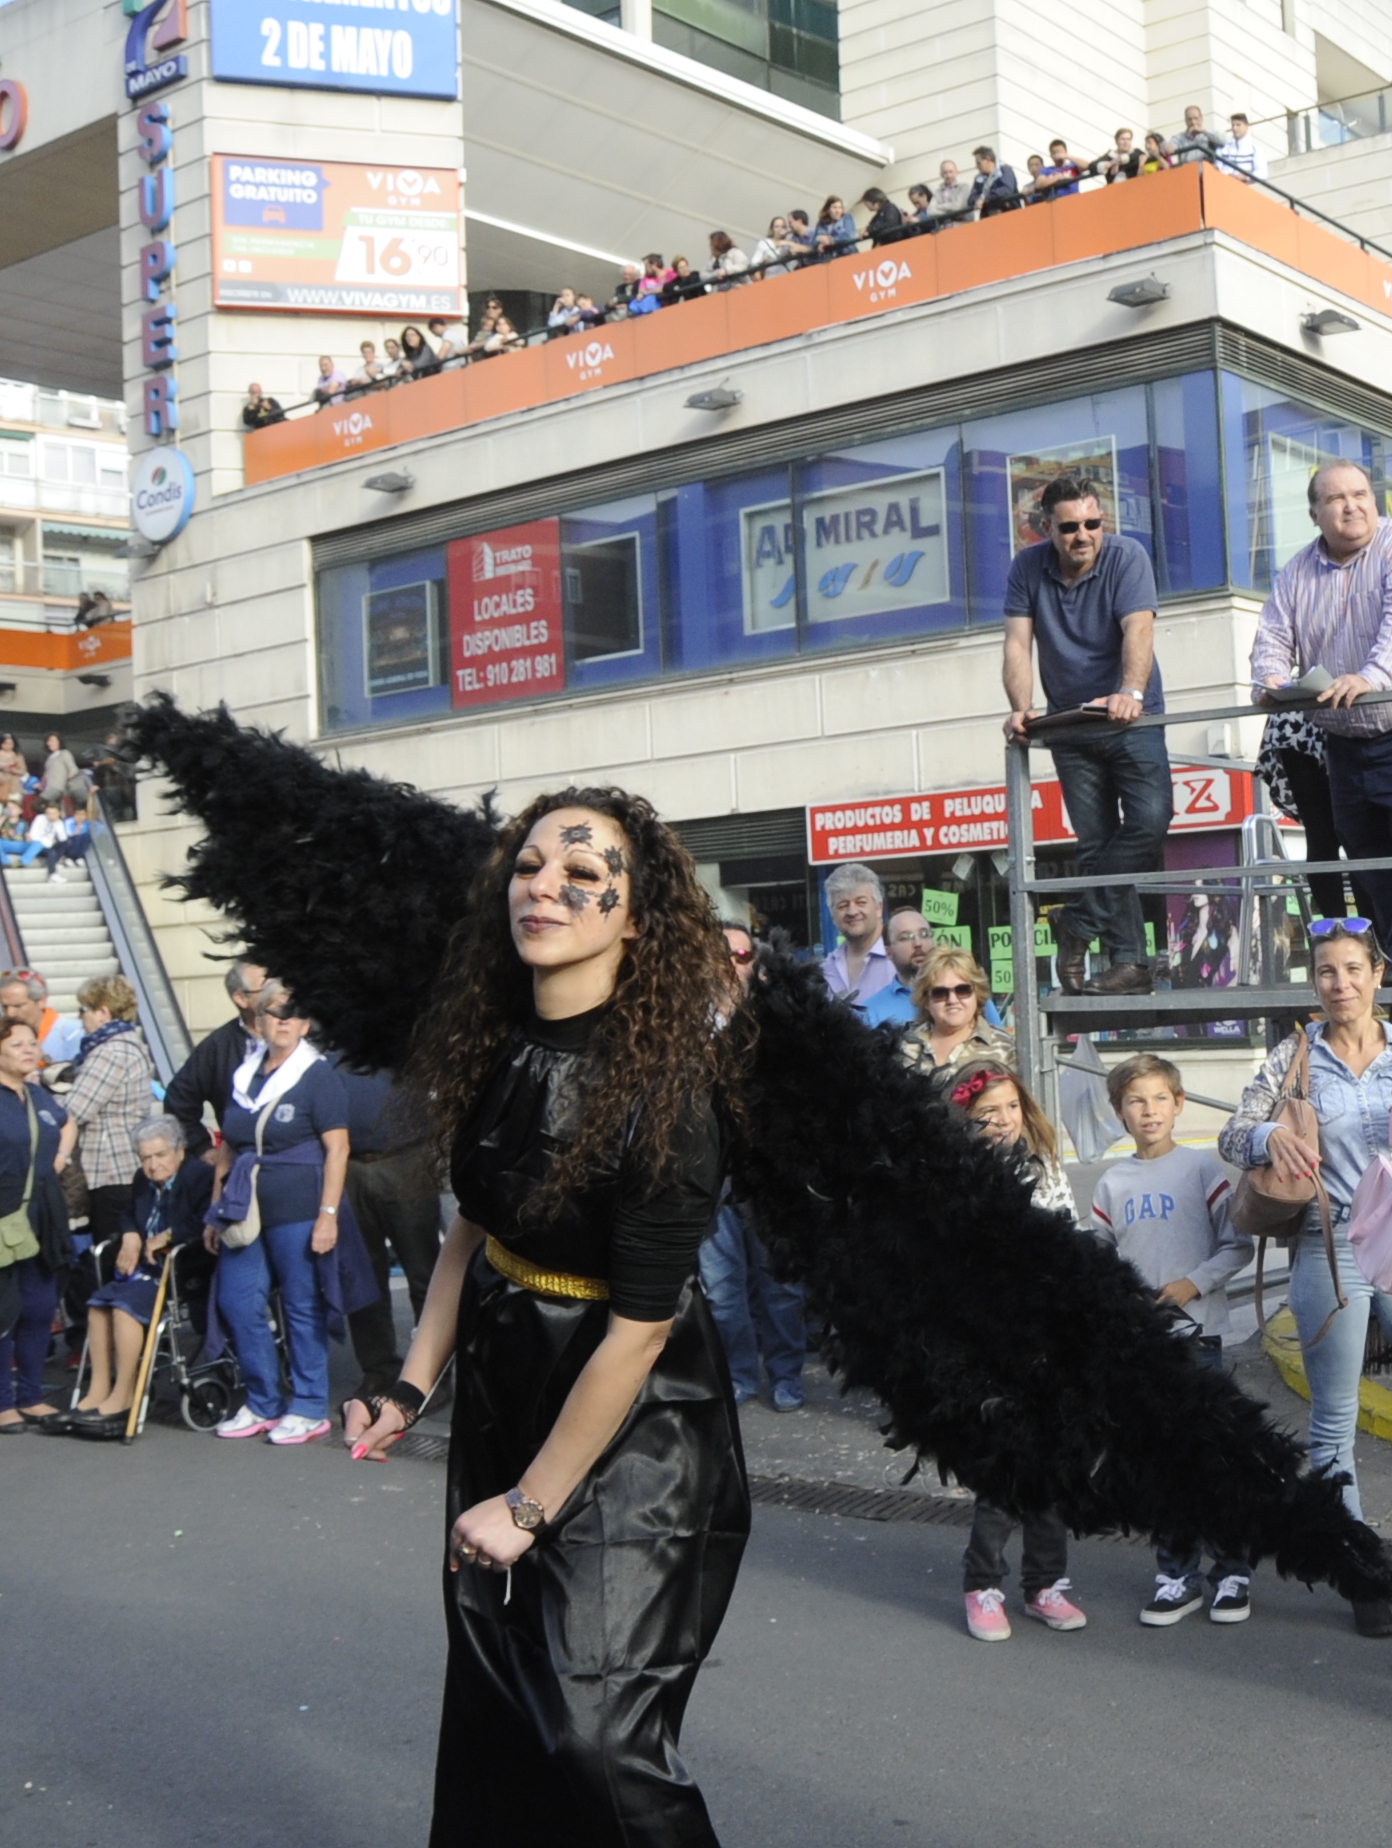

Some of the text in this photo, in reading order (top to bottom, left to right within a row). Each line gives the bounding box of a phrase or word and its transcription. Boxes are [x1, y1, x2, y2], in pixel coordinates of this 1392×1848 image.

[261, 17, 413, 79] 2 DE MAYO
[129, 61, 177, 93] MAYO
[229, 165, 318, 188] PARKING
[366, 170, 442, 196] VIVA
[229, 184, 318, 204] GRATUITO
[387, 196, 422, 207] GYM
[358, 213, 374, 224] TU
[376, 215, 406, 226] GYM
[136, 101, 178, 437] SUPER
[852, 260, 912, 291] VIVA
[286, 288, 451, 310] WWW.VIVAGYM.ES
[869, 287, 897, 303] GYM
[565, 342, 614, 369] VIVA
[579, 367, 602, 380] GYM
[333, 412, 373, 436] VIVA
[137, 482, 183, 510] Condis
[494, 544, 533, 564] TRATO
[473, 587, 535, 623] LOCALES
[462, 619, 549, 658] DISPONIBLES
[456, 667, 485, 692] TEL:
[486, 661, 509, 687] 910
[510, 657, 533, 683] 281
[534, 652, 557, 679] 981
[815, 790, 1044, 831] PRODUCTOS DE PELUQUA
[828, 820, 1010, 856] PERFUMERIA Y COSMETI
[924, 899, 955, 918] 50%
[991, 931, 1012, 949] PO
[994, 970, 1012, 984] 50
[1124, 1193, 1175, 1226] GAP
